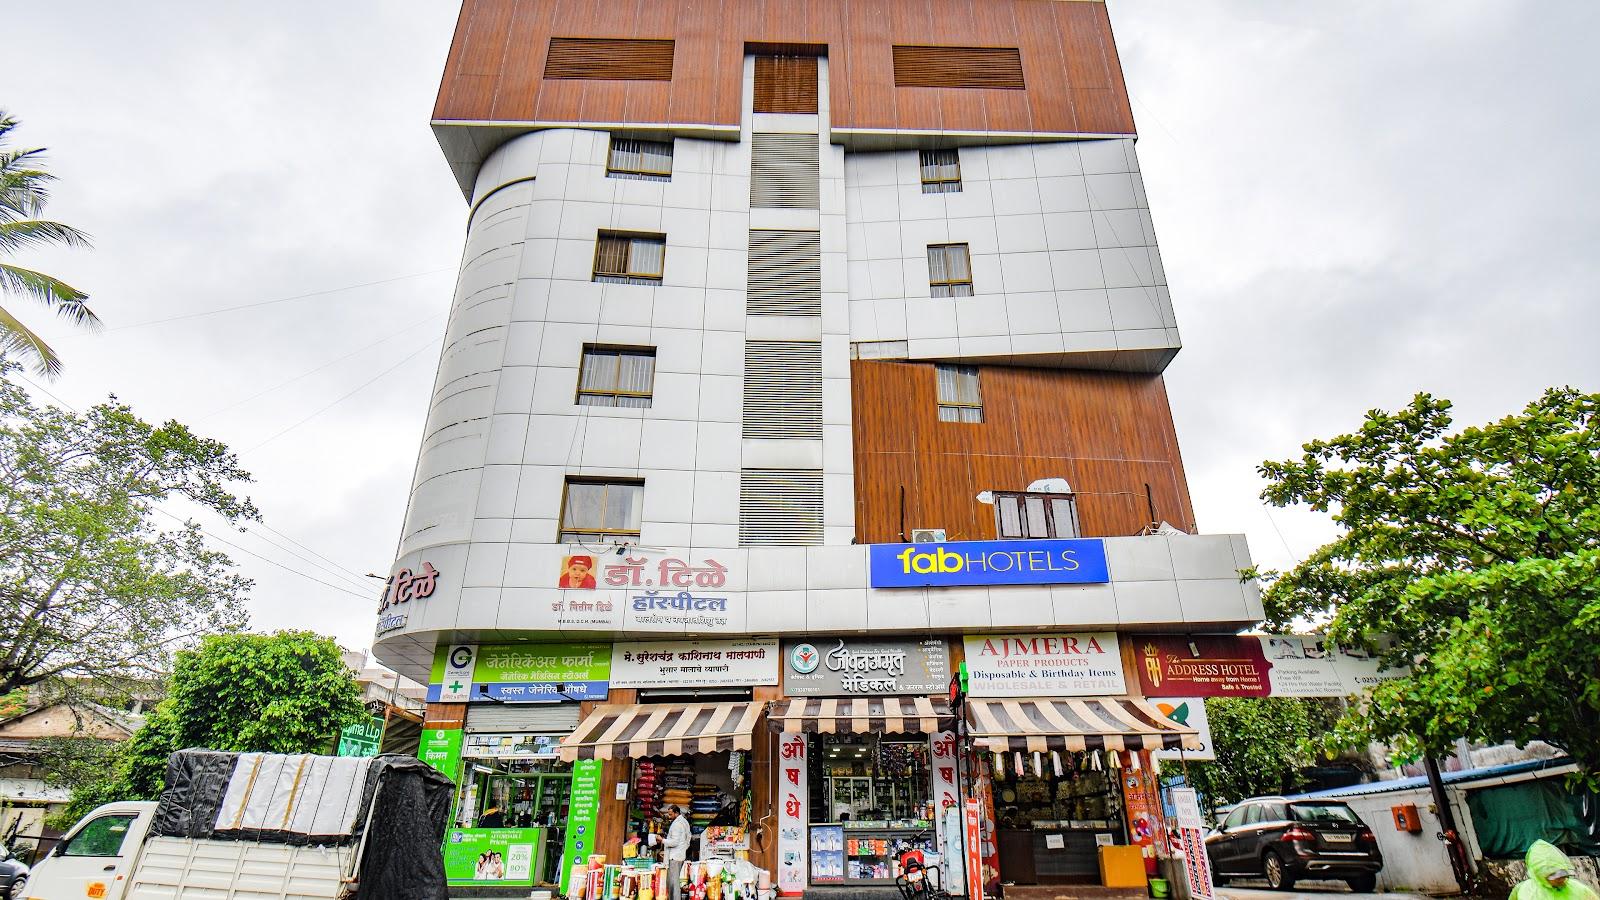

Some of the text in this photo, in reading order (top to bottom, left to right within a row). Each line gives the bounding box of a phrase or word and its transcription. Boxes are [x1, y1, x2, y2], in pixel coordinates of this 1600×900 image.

[897, 547, 1080, 574] fabHOTELS
[979, 636, 1106, 659] AJMERA
[997, 658, 1089, 668] PAPER PRODUCTS
[973, 669, 1116, 681] Disposable & Birthday Items
[1167, 664, 1260, 675] ADDRESS HOTEL
[841, 673, 897, 692] मेडिकल
[973, 679, 1119, 691] WHOLESALE & RETAIL
